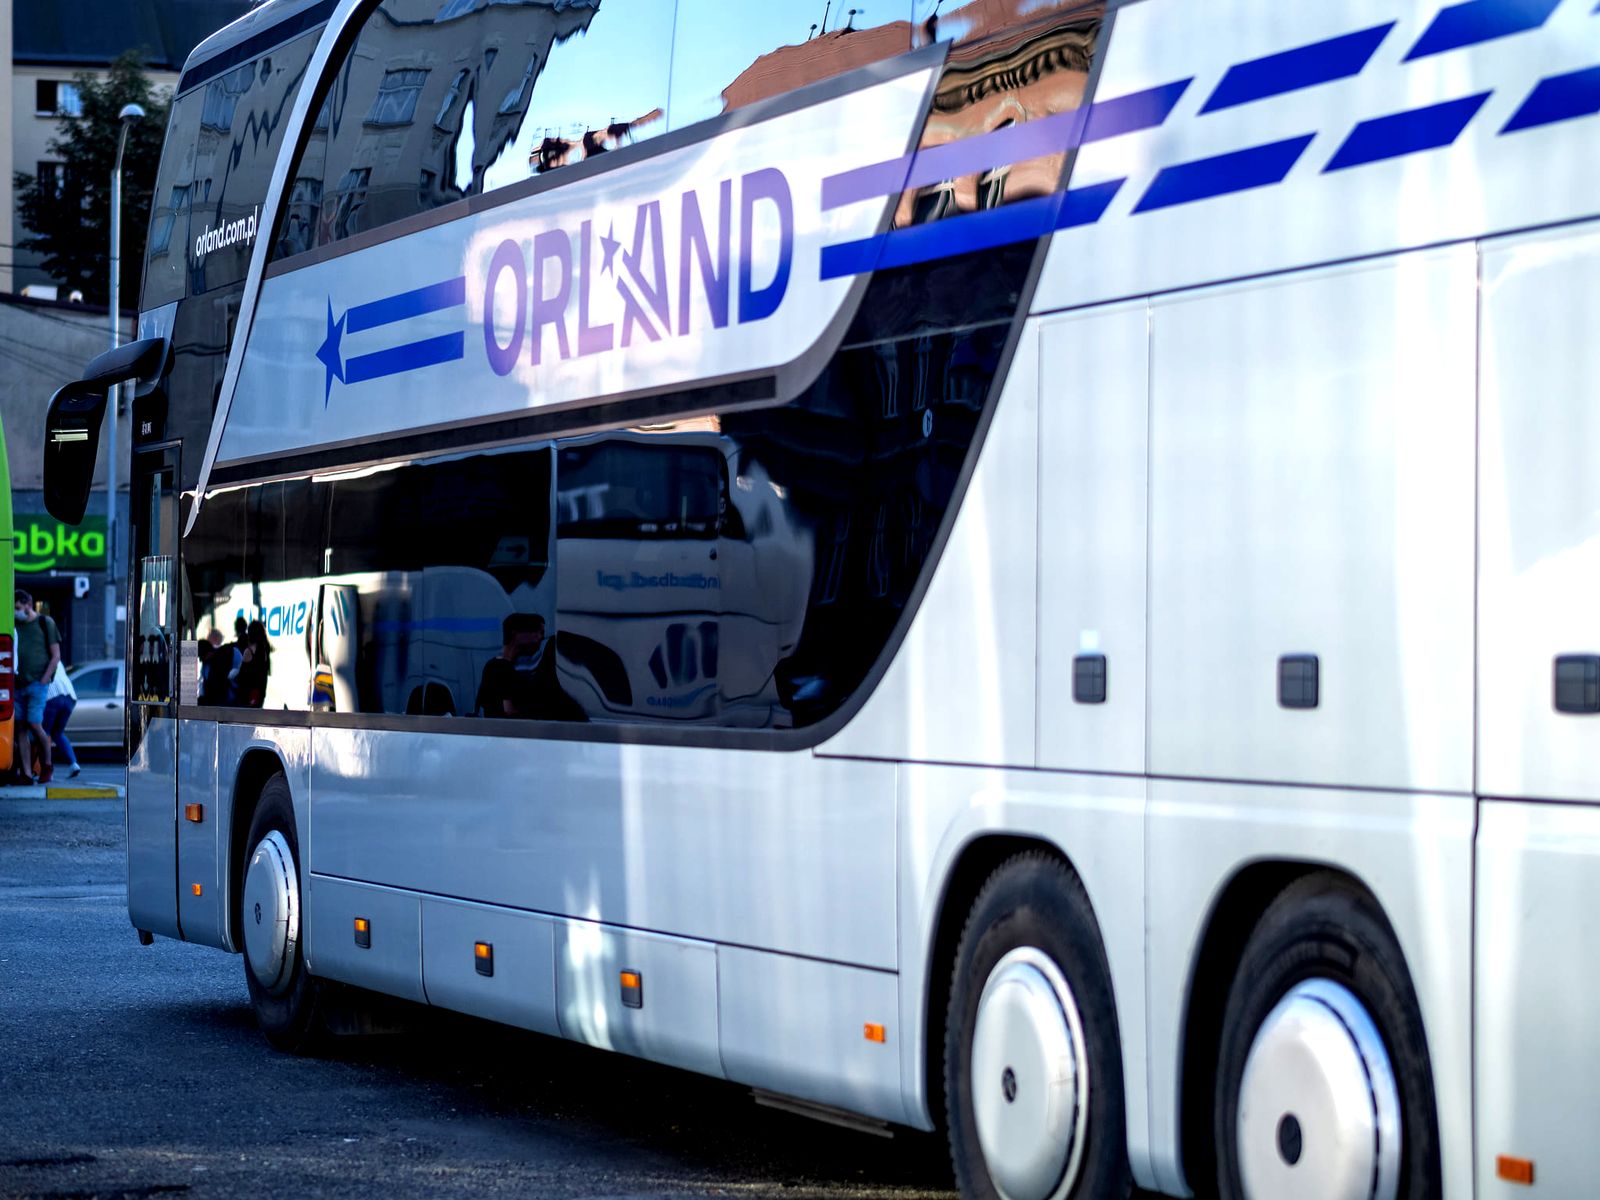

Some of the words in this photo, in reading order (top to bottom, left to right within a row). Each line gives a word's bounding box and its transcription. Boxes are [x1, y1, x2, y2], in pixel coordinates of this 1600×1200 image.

[195, 205, 258, 257] orland.com.pl
[484, 167, 794, 377] ORLAND
[13, 524, 105, 556] abka
